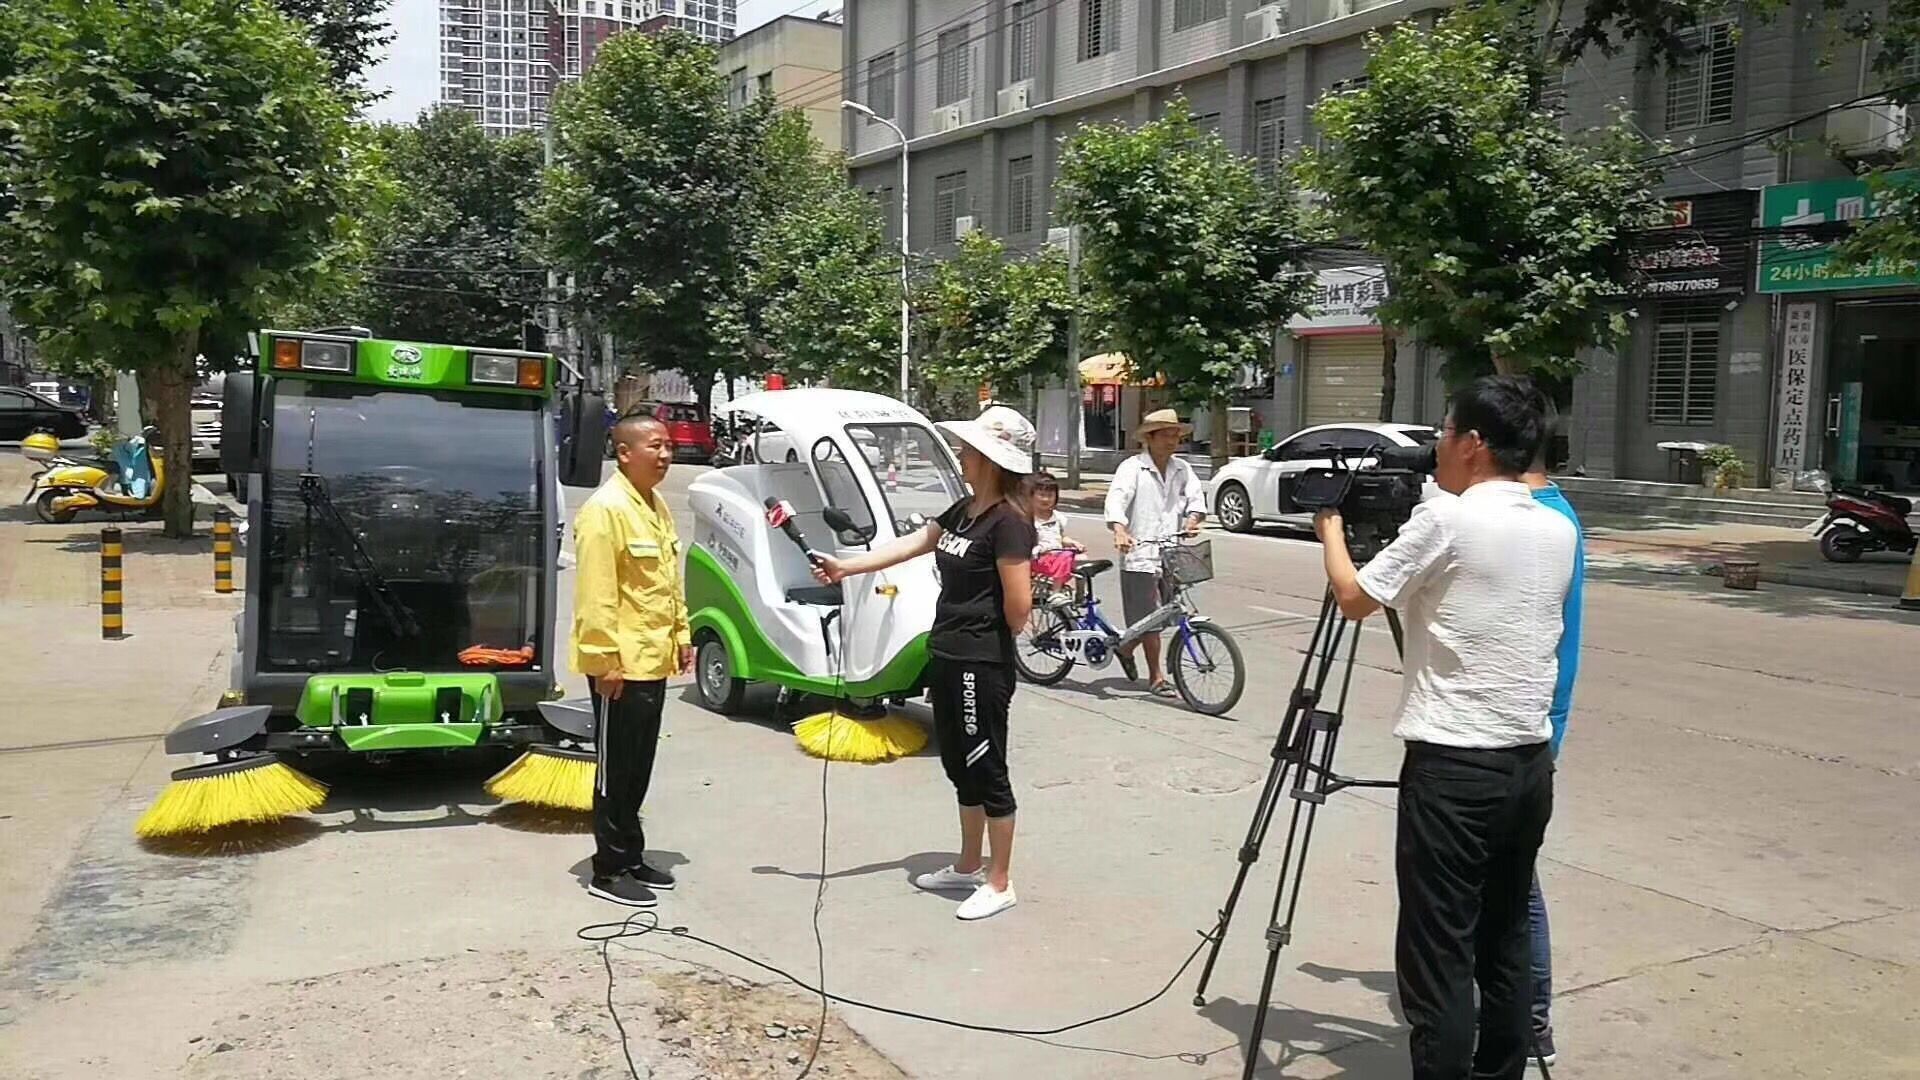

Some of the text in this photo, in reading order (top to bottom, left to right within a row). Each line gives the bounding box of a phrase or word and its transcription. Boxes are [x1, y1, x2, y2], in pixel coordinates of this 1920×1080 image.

[1782, 348, 1806, 465] 医保定点药店
[963, 672, 977, 723] SPORTS
